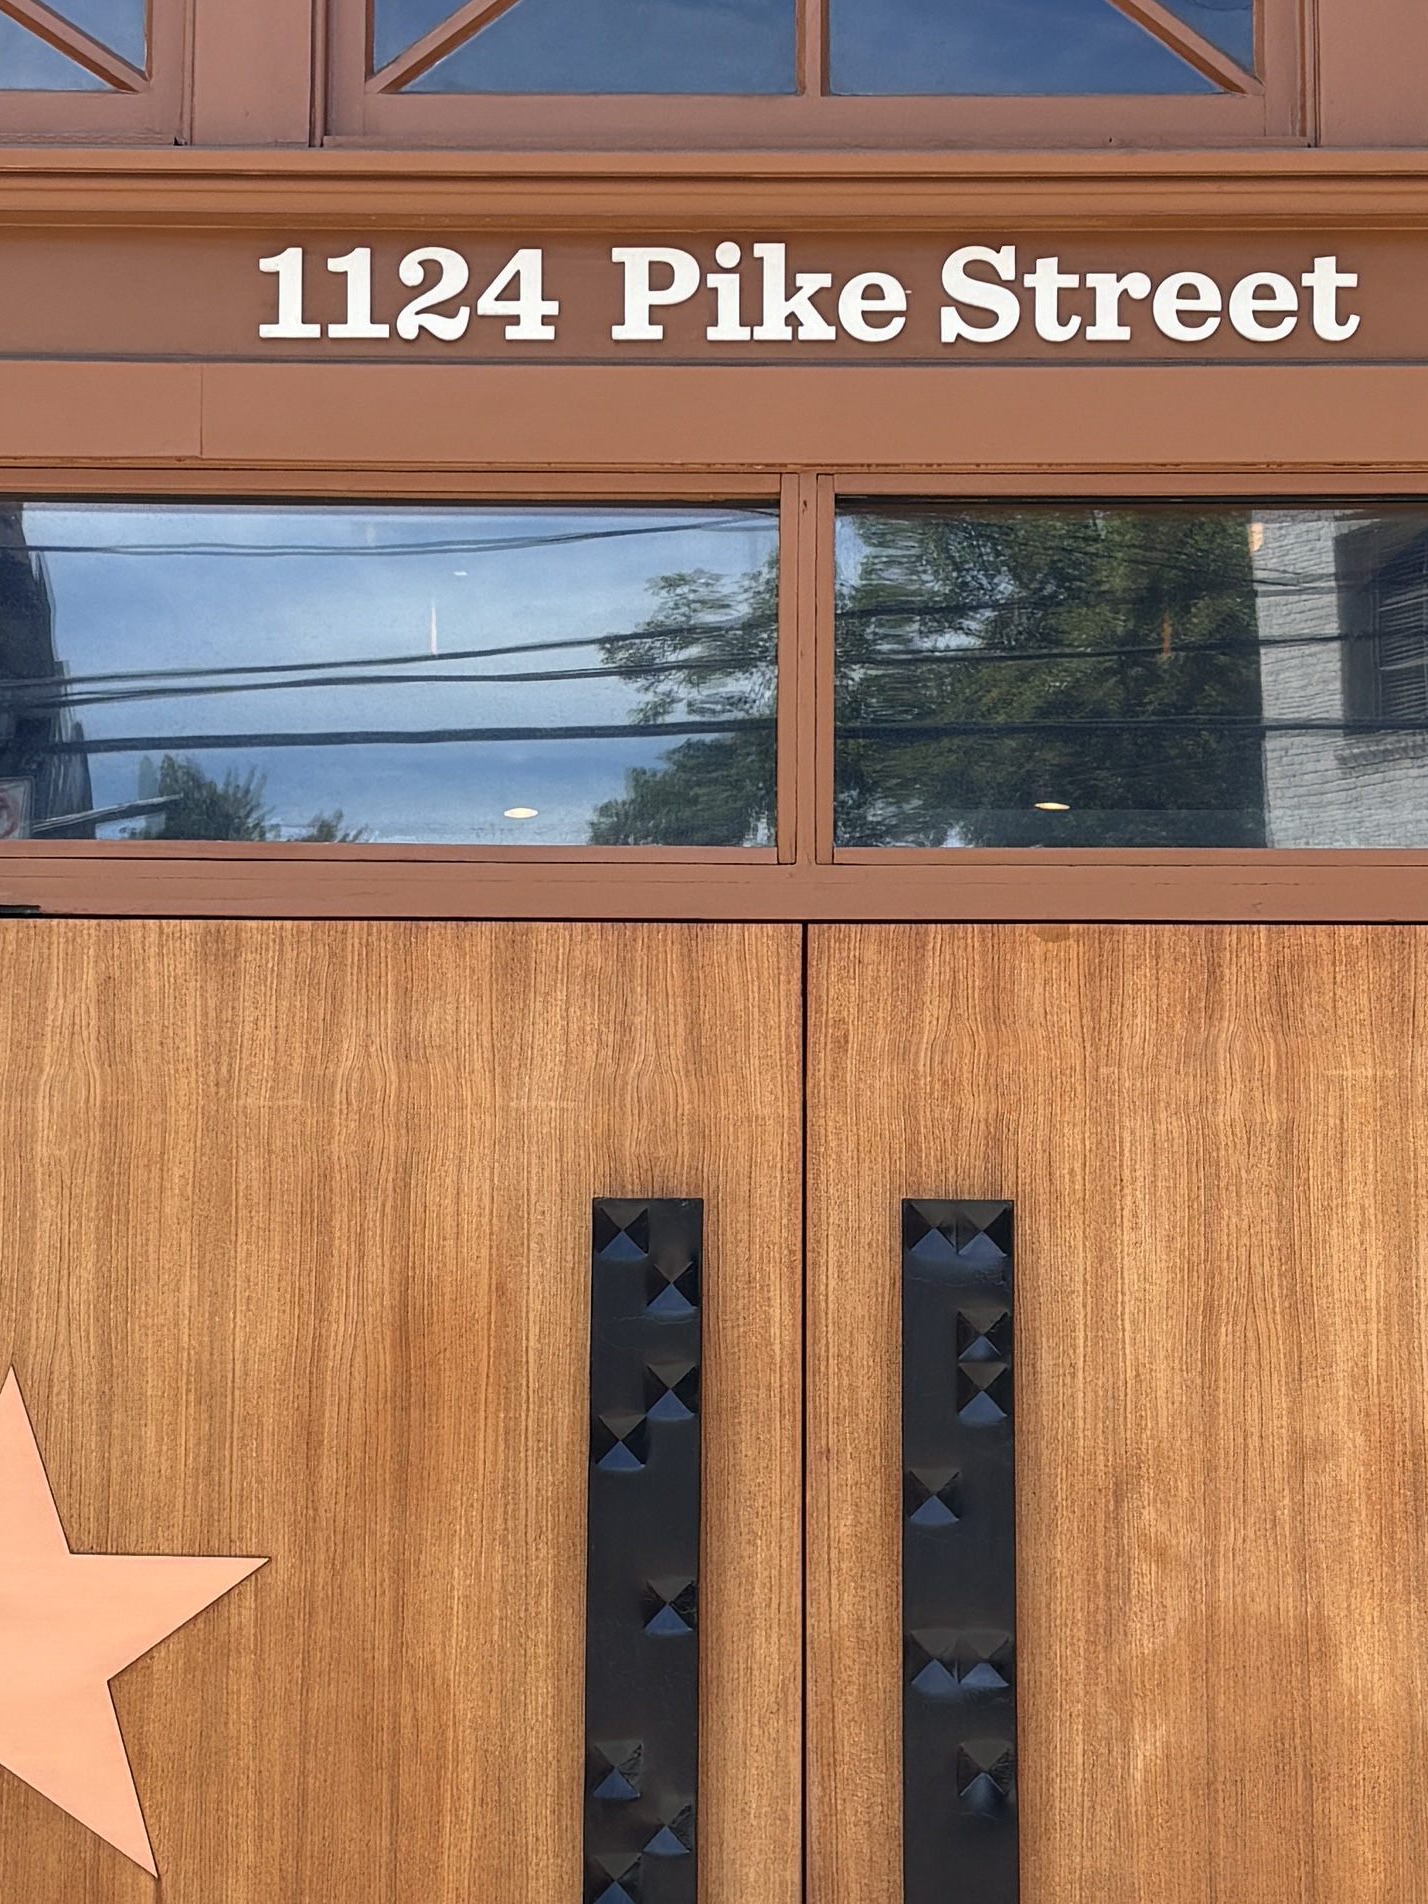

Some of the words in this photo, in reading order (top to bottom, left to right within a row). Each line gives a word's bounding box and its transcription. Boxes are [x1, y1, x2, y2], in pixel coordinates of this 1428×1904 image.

[259, 247, 559, 340] 1124
[612, 242, 911, 341] Pike
[941, 246, 1360, 342] Street
